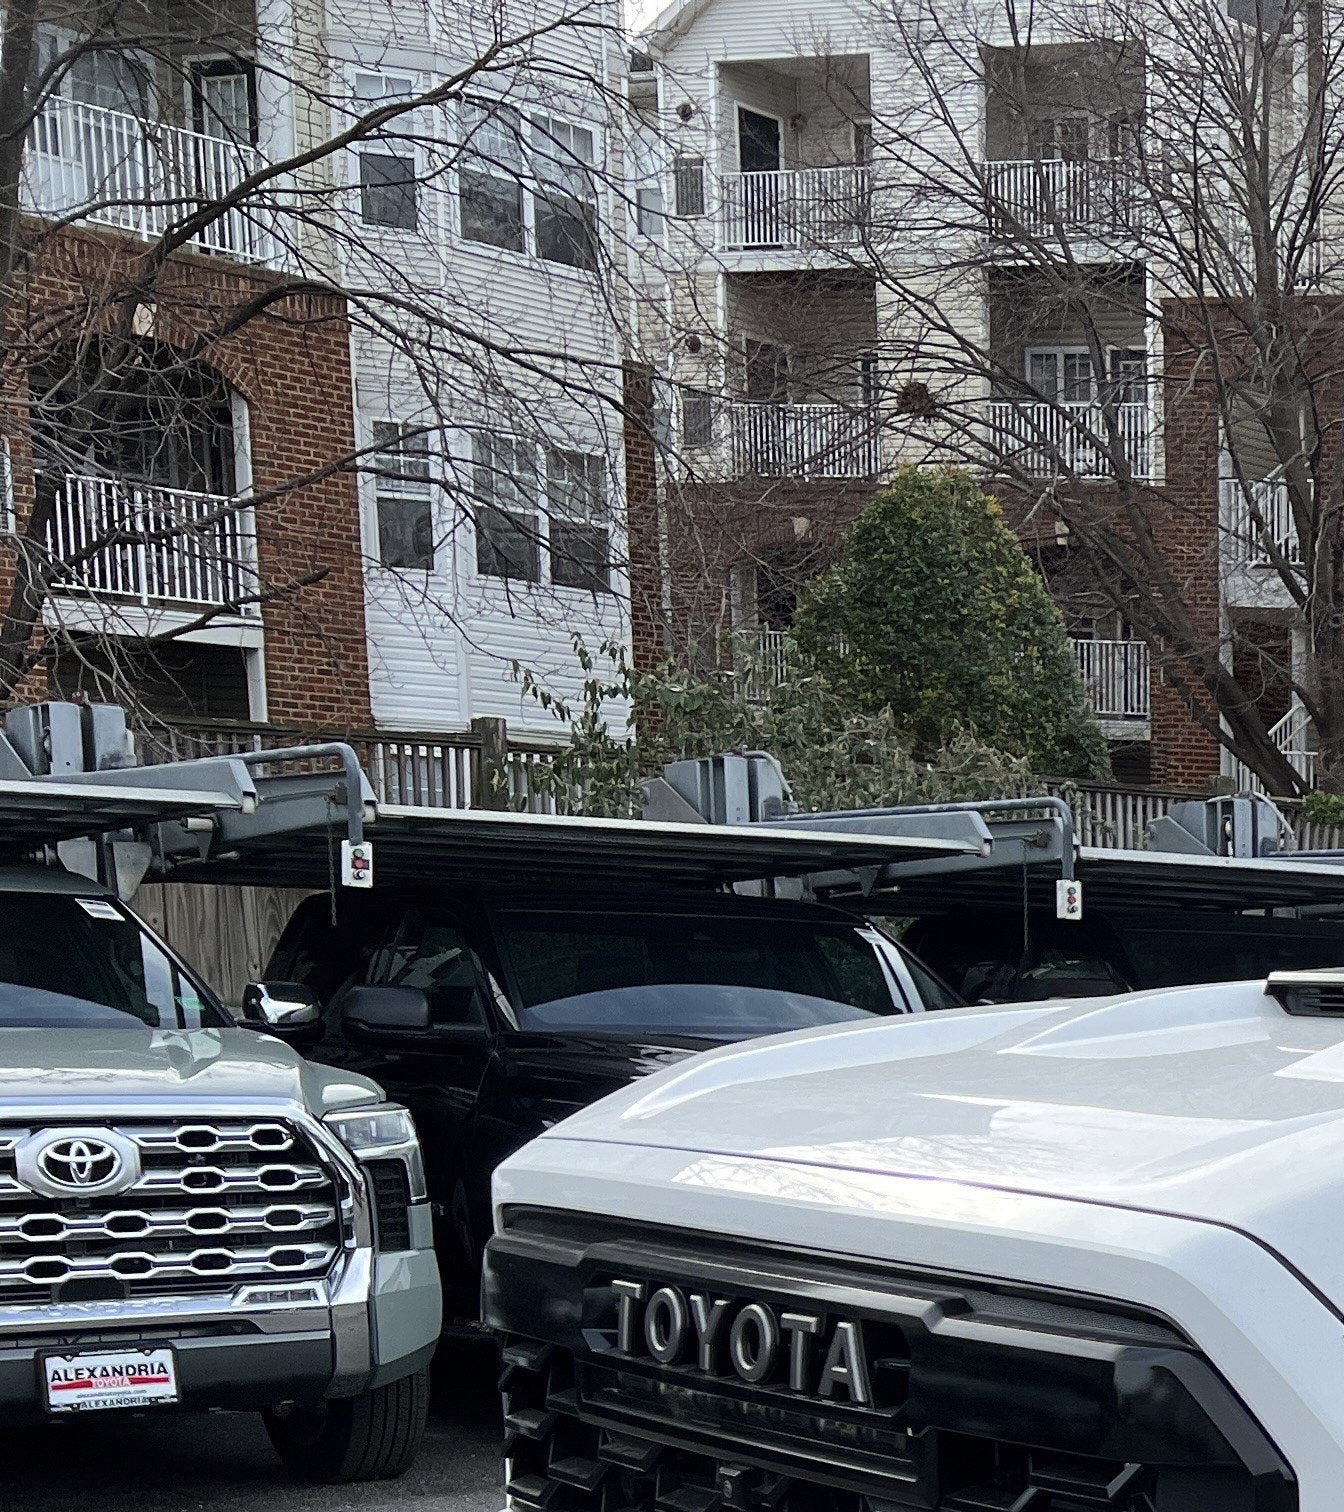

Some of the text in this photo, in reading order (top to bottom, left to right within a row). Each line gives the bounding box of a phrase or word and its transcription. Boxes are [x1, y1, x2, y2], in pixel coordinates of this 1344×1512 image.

[611, 1279, 872, 1405] TOYOTA
[50, 1362, 169, 1382] ALEXANDRIA
[92, 1377, 131, 1389] TOYOTA
[81, 1396, 150, 1409] ALEXANDRIA
